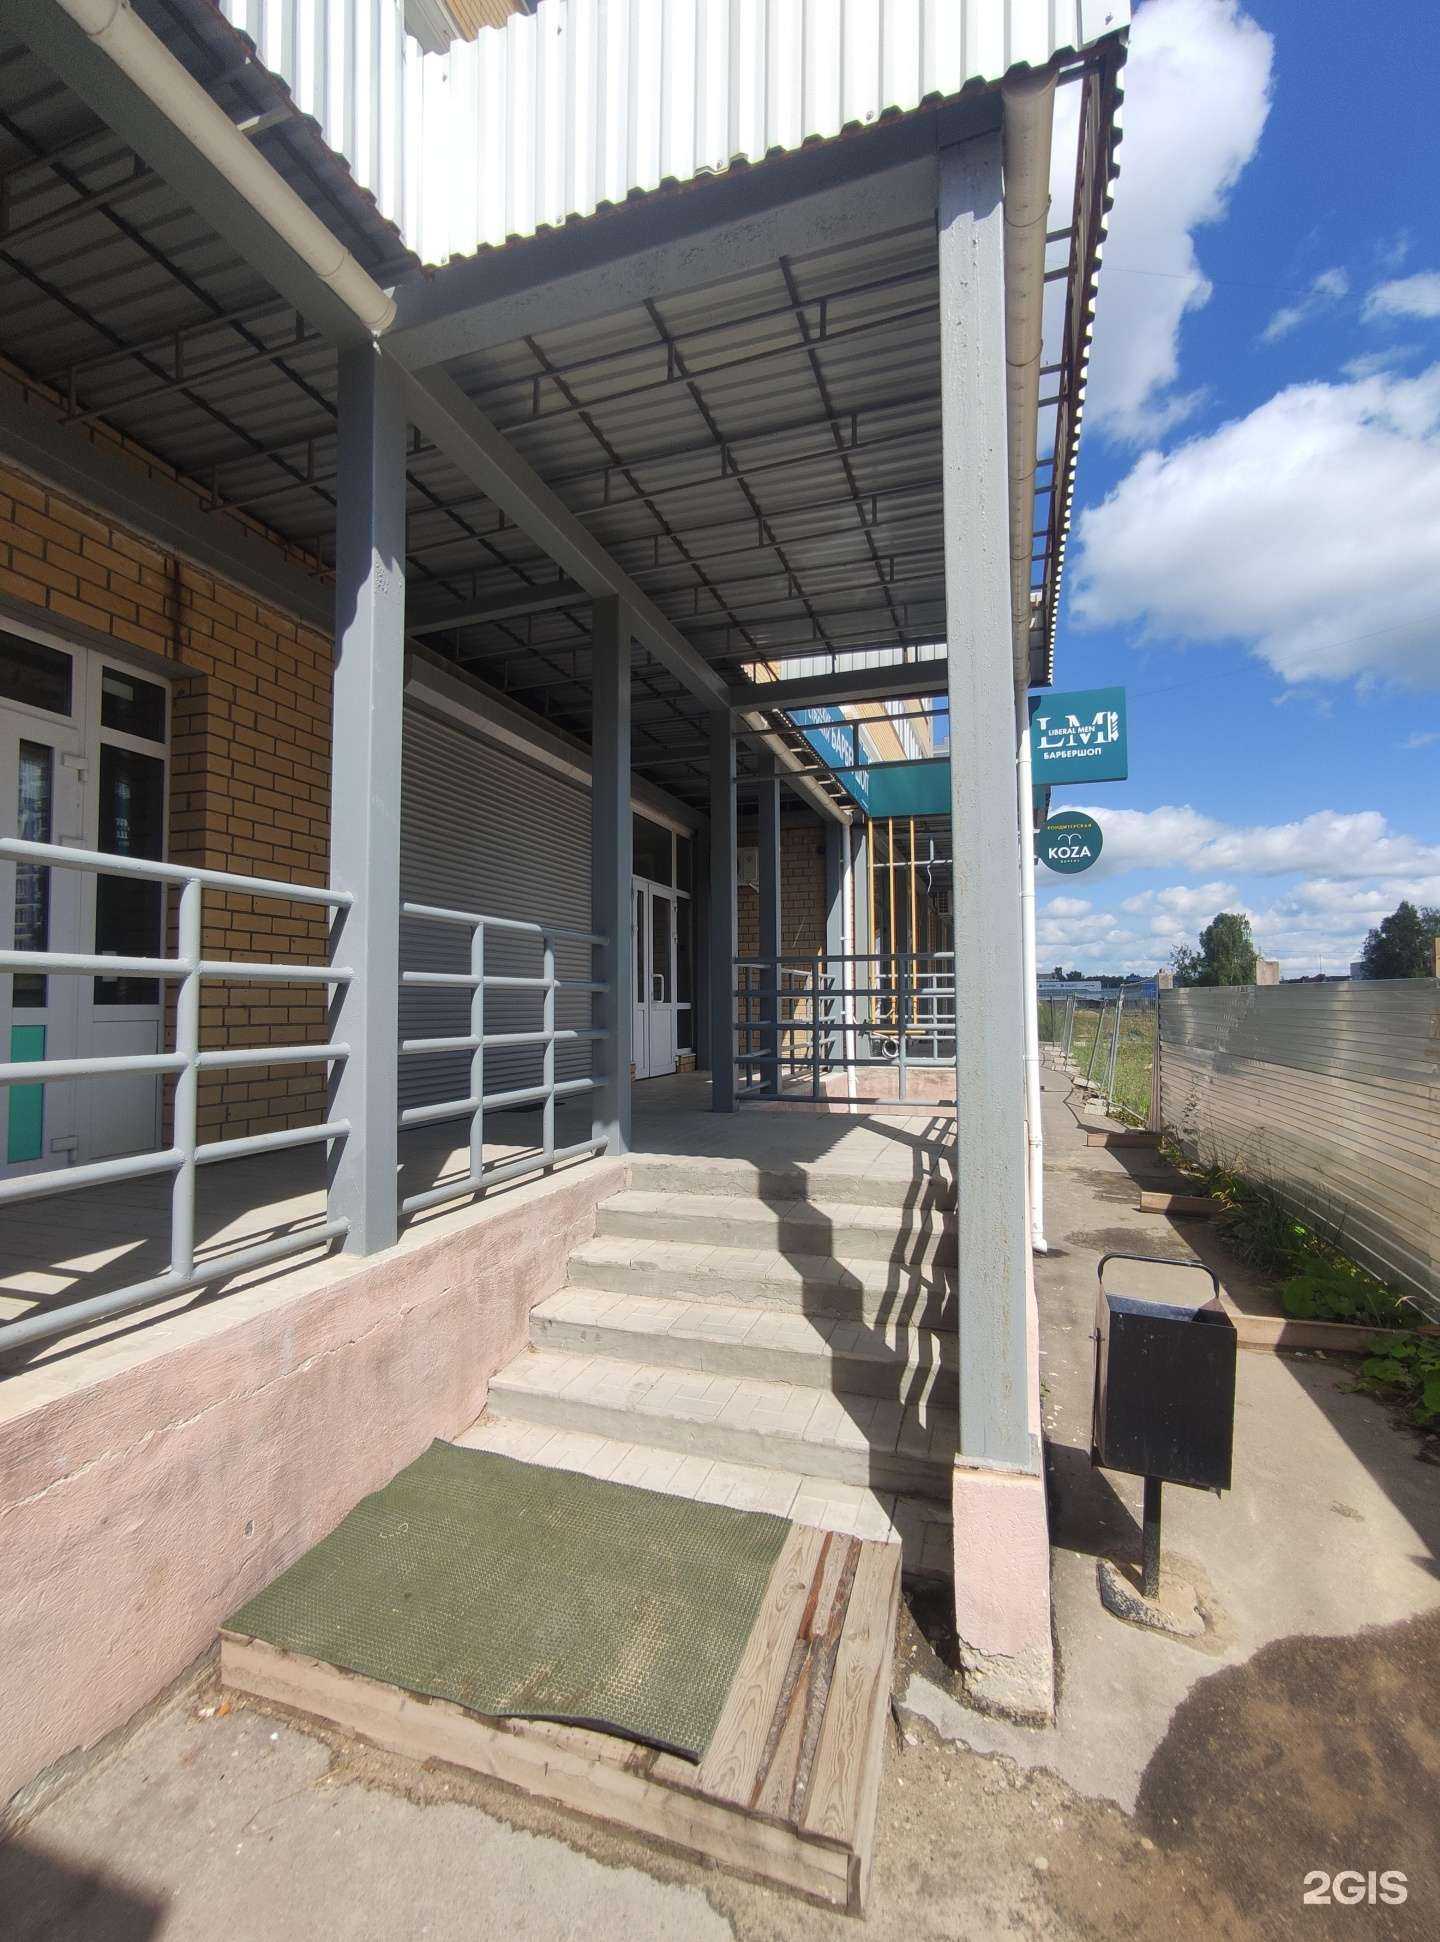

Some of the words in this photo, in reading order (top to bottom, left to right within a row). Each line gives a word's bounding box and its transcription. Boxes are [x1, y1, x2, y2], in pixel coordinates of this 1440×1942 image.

[1048, 728, 1076, 736] LIBERAL
[1043, 747, 1102, 760] БАРБЕРШОП
[1048, 845, 1092, 859] KOZA
